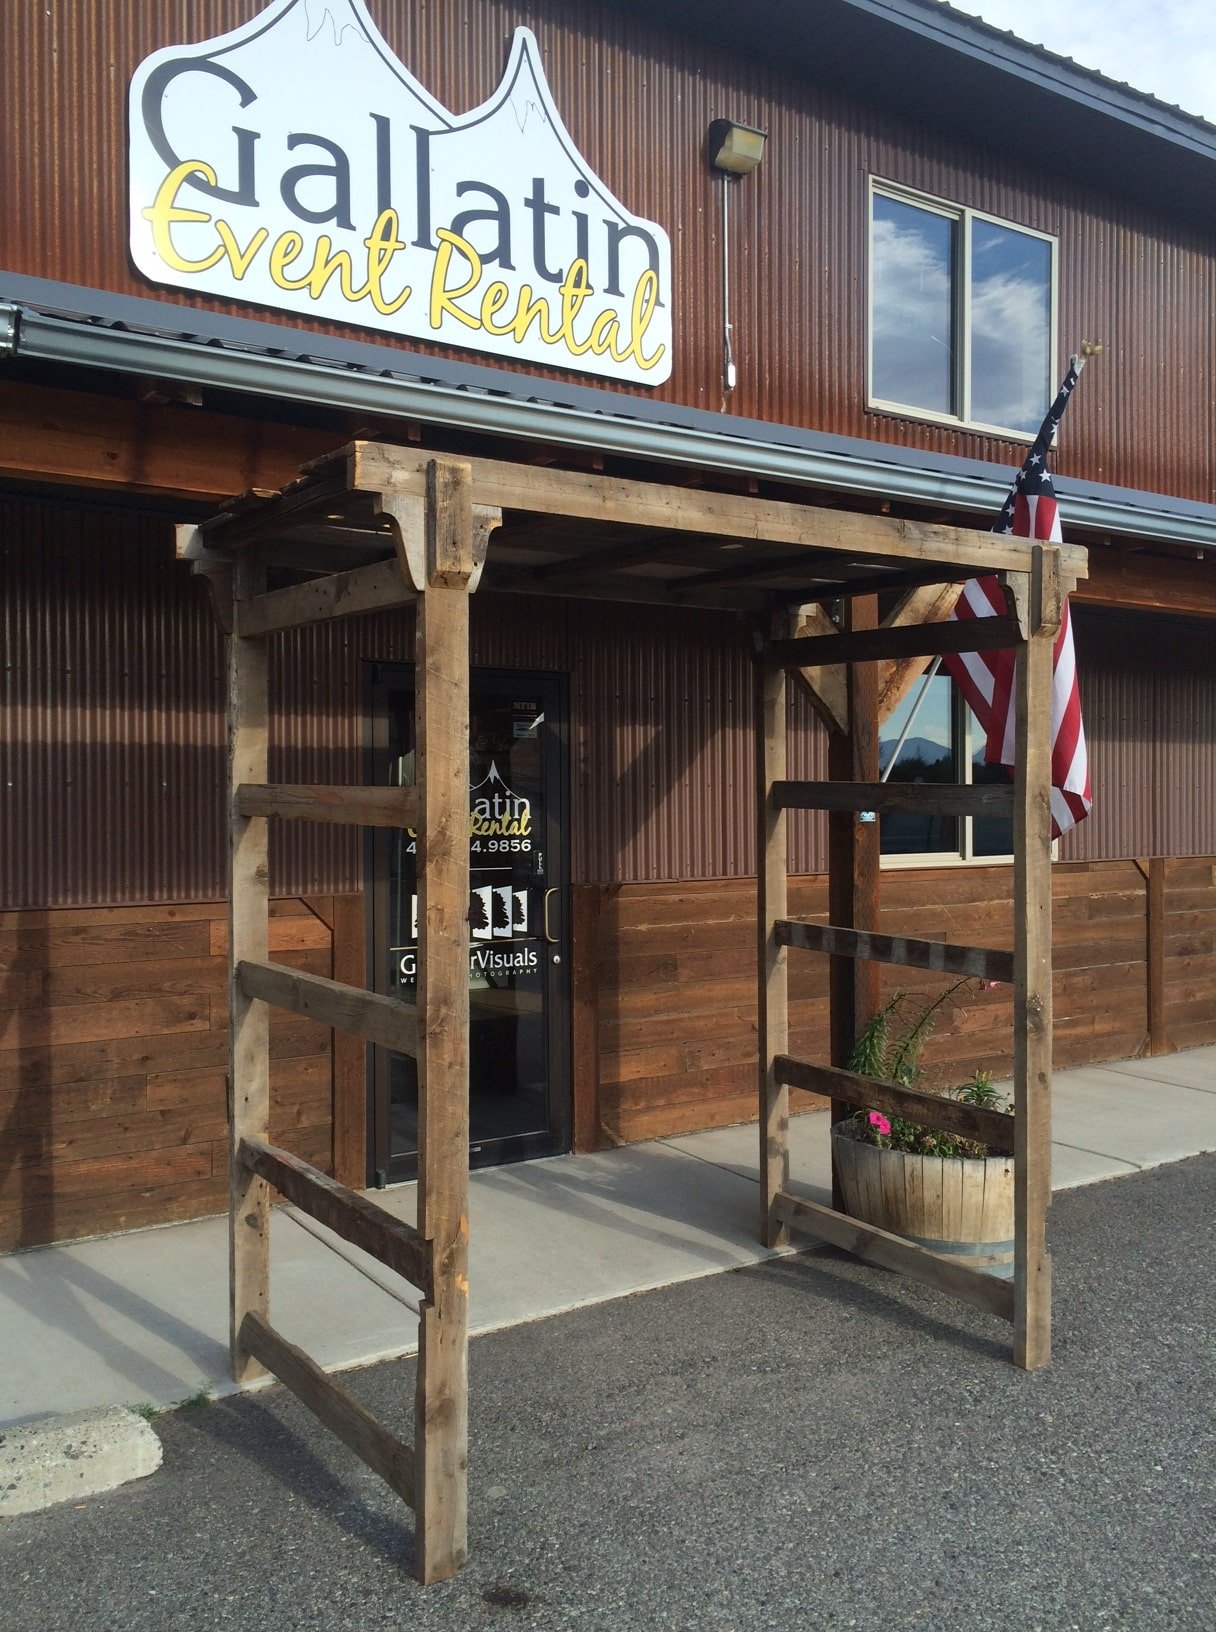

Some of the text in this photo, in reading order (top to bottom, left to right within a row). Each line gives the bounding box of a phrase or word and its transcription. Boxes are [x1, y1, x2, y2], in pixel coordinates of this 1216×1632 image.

[142, 55, 665, 308] Gallatin
[142, 159, 665, 370] Event Rental
[475, 790, 532, 819] atin
